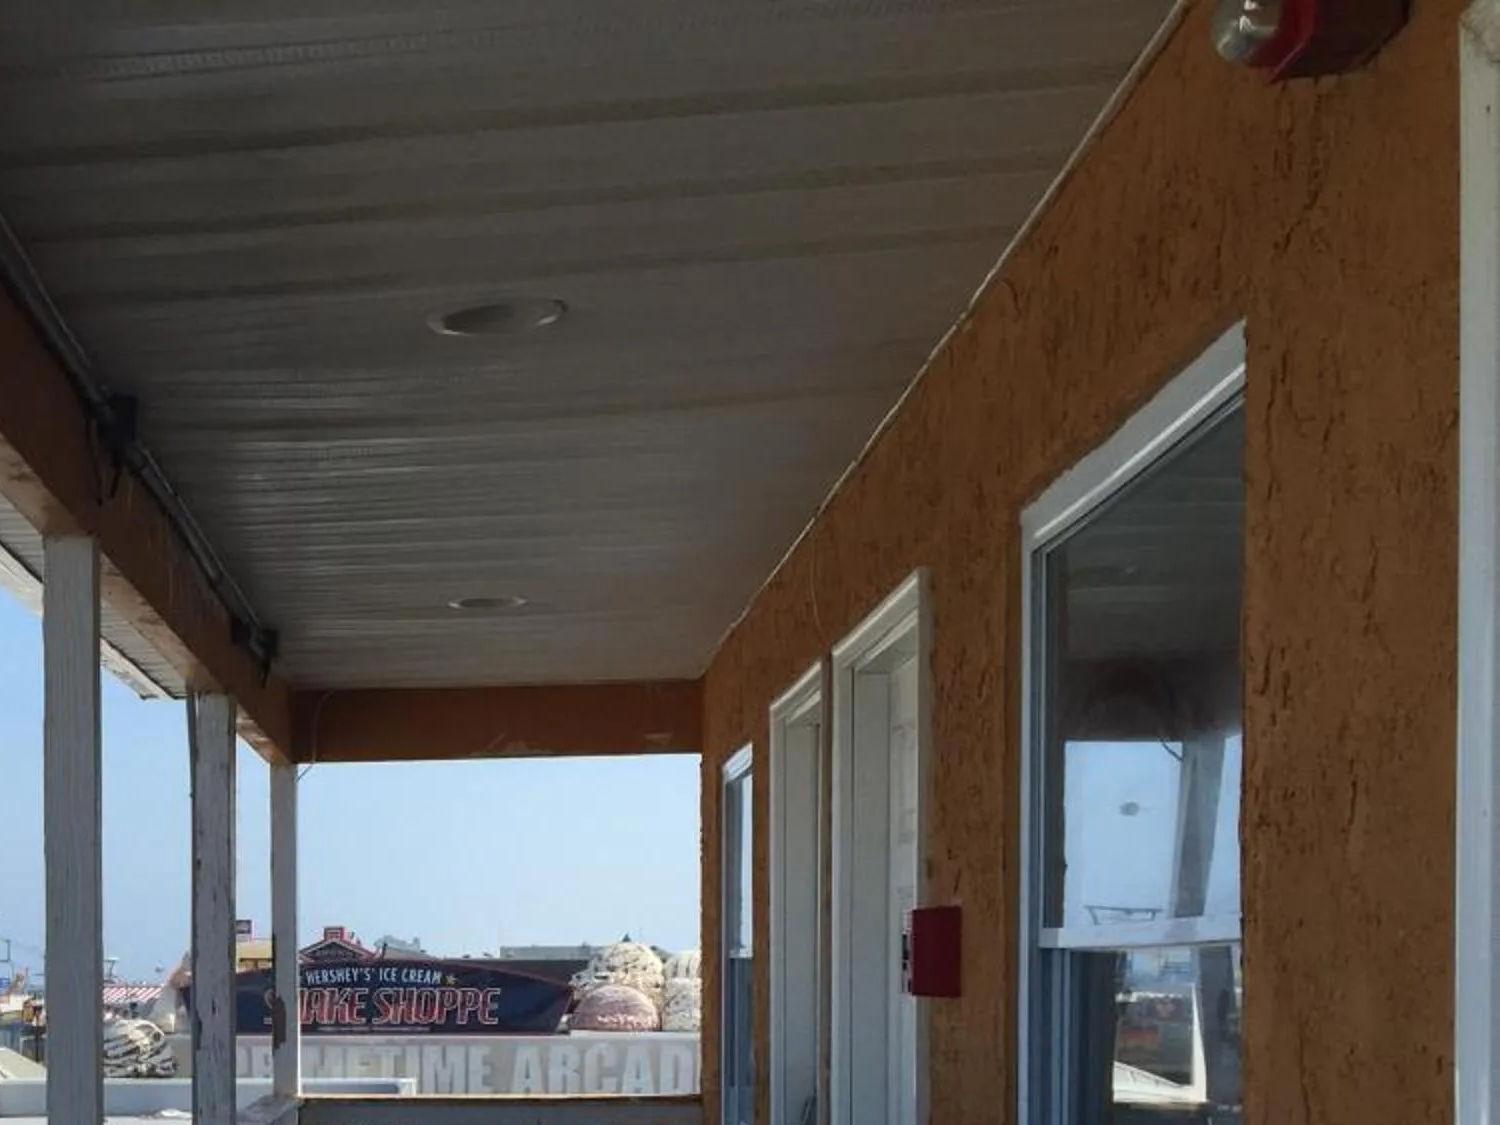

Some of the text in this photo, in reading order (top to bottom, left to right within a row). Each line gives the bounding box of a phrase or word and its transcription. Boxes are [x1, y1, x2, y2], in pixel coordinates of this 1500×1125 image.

[305, 967, 442, 986] HERSHEY'S ICE CREAM
[263, 987, 501, 1025] AKE SHOPPE
